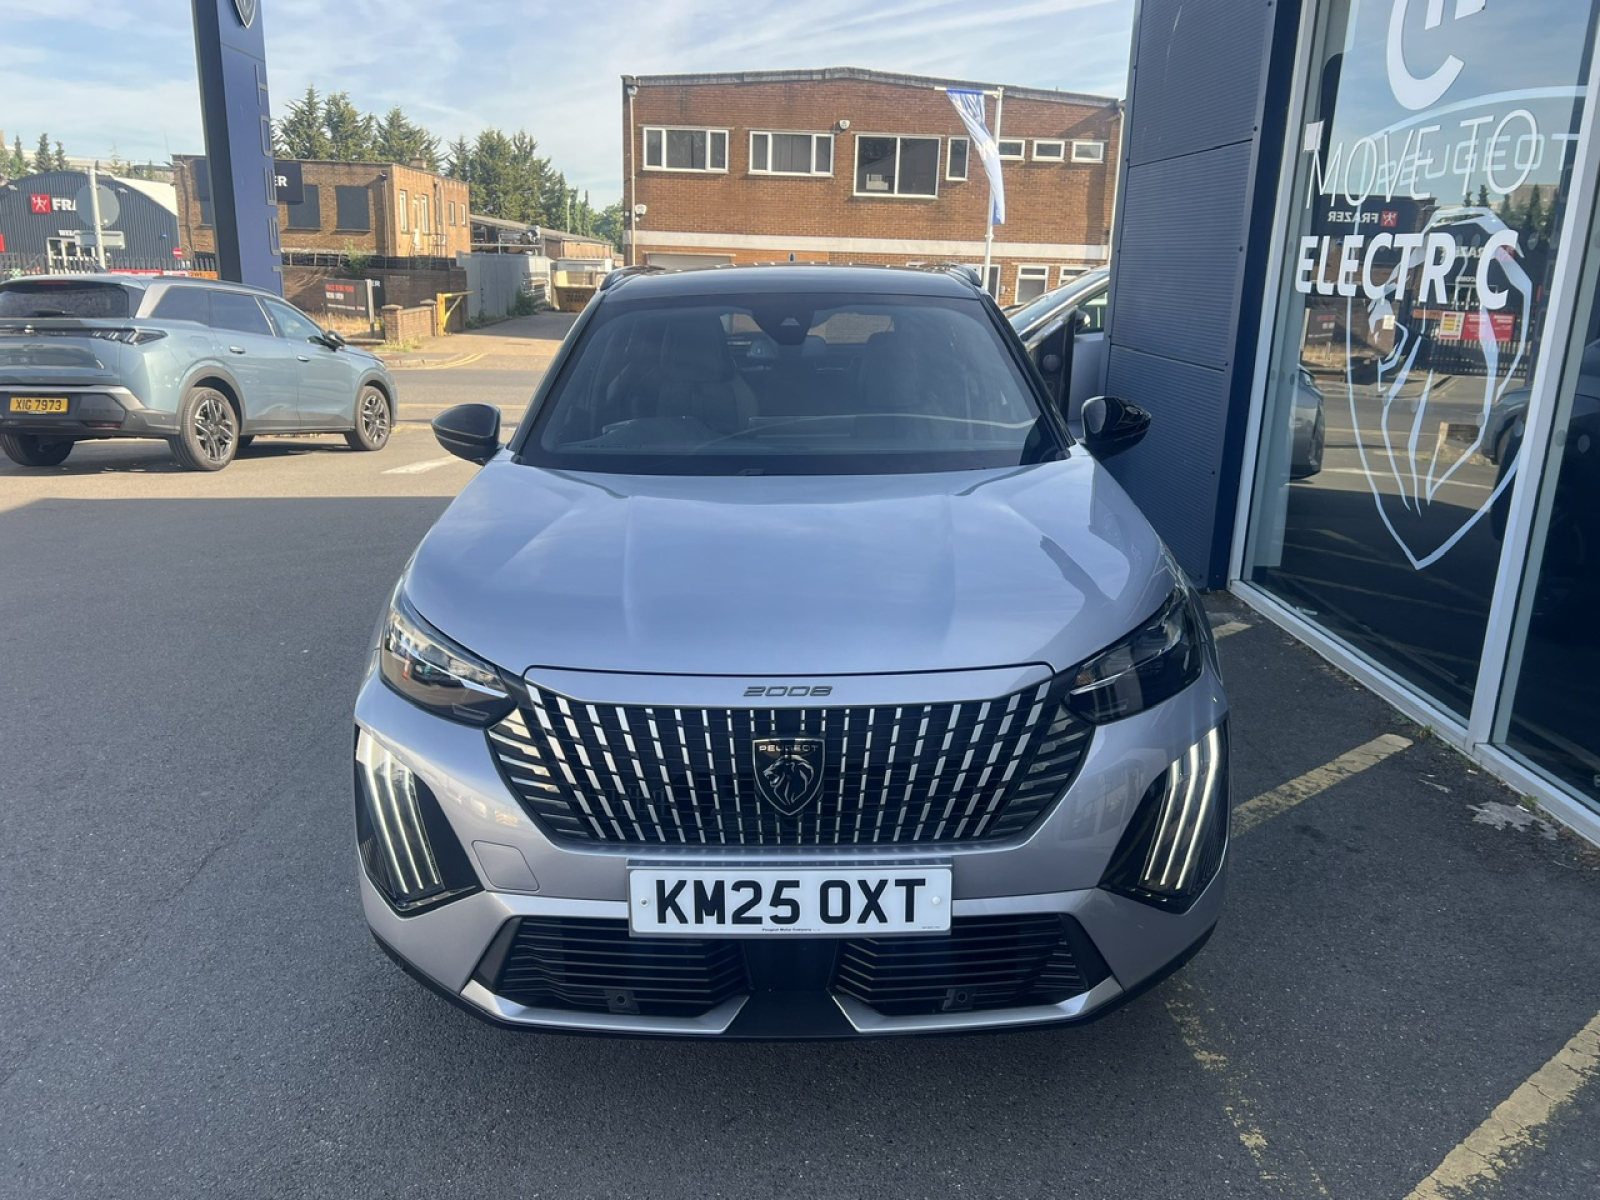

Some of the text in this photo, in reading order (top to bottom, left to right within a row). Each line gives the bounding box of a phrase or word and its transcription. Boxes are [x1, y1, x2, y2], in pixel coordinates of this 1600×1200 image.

[1306, 109, 1538, 209] MOVE TO
[1375, 134, 1581, 194] PEUGEOT
[16, 399, 62, 411] XIG 7973
[743, 686, 833, 697] 2008
[655, 878, 926, 925] KM25 OXT
